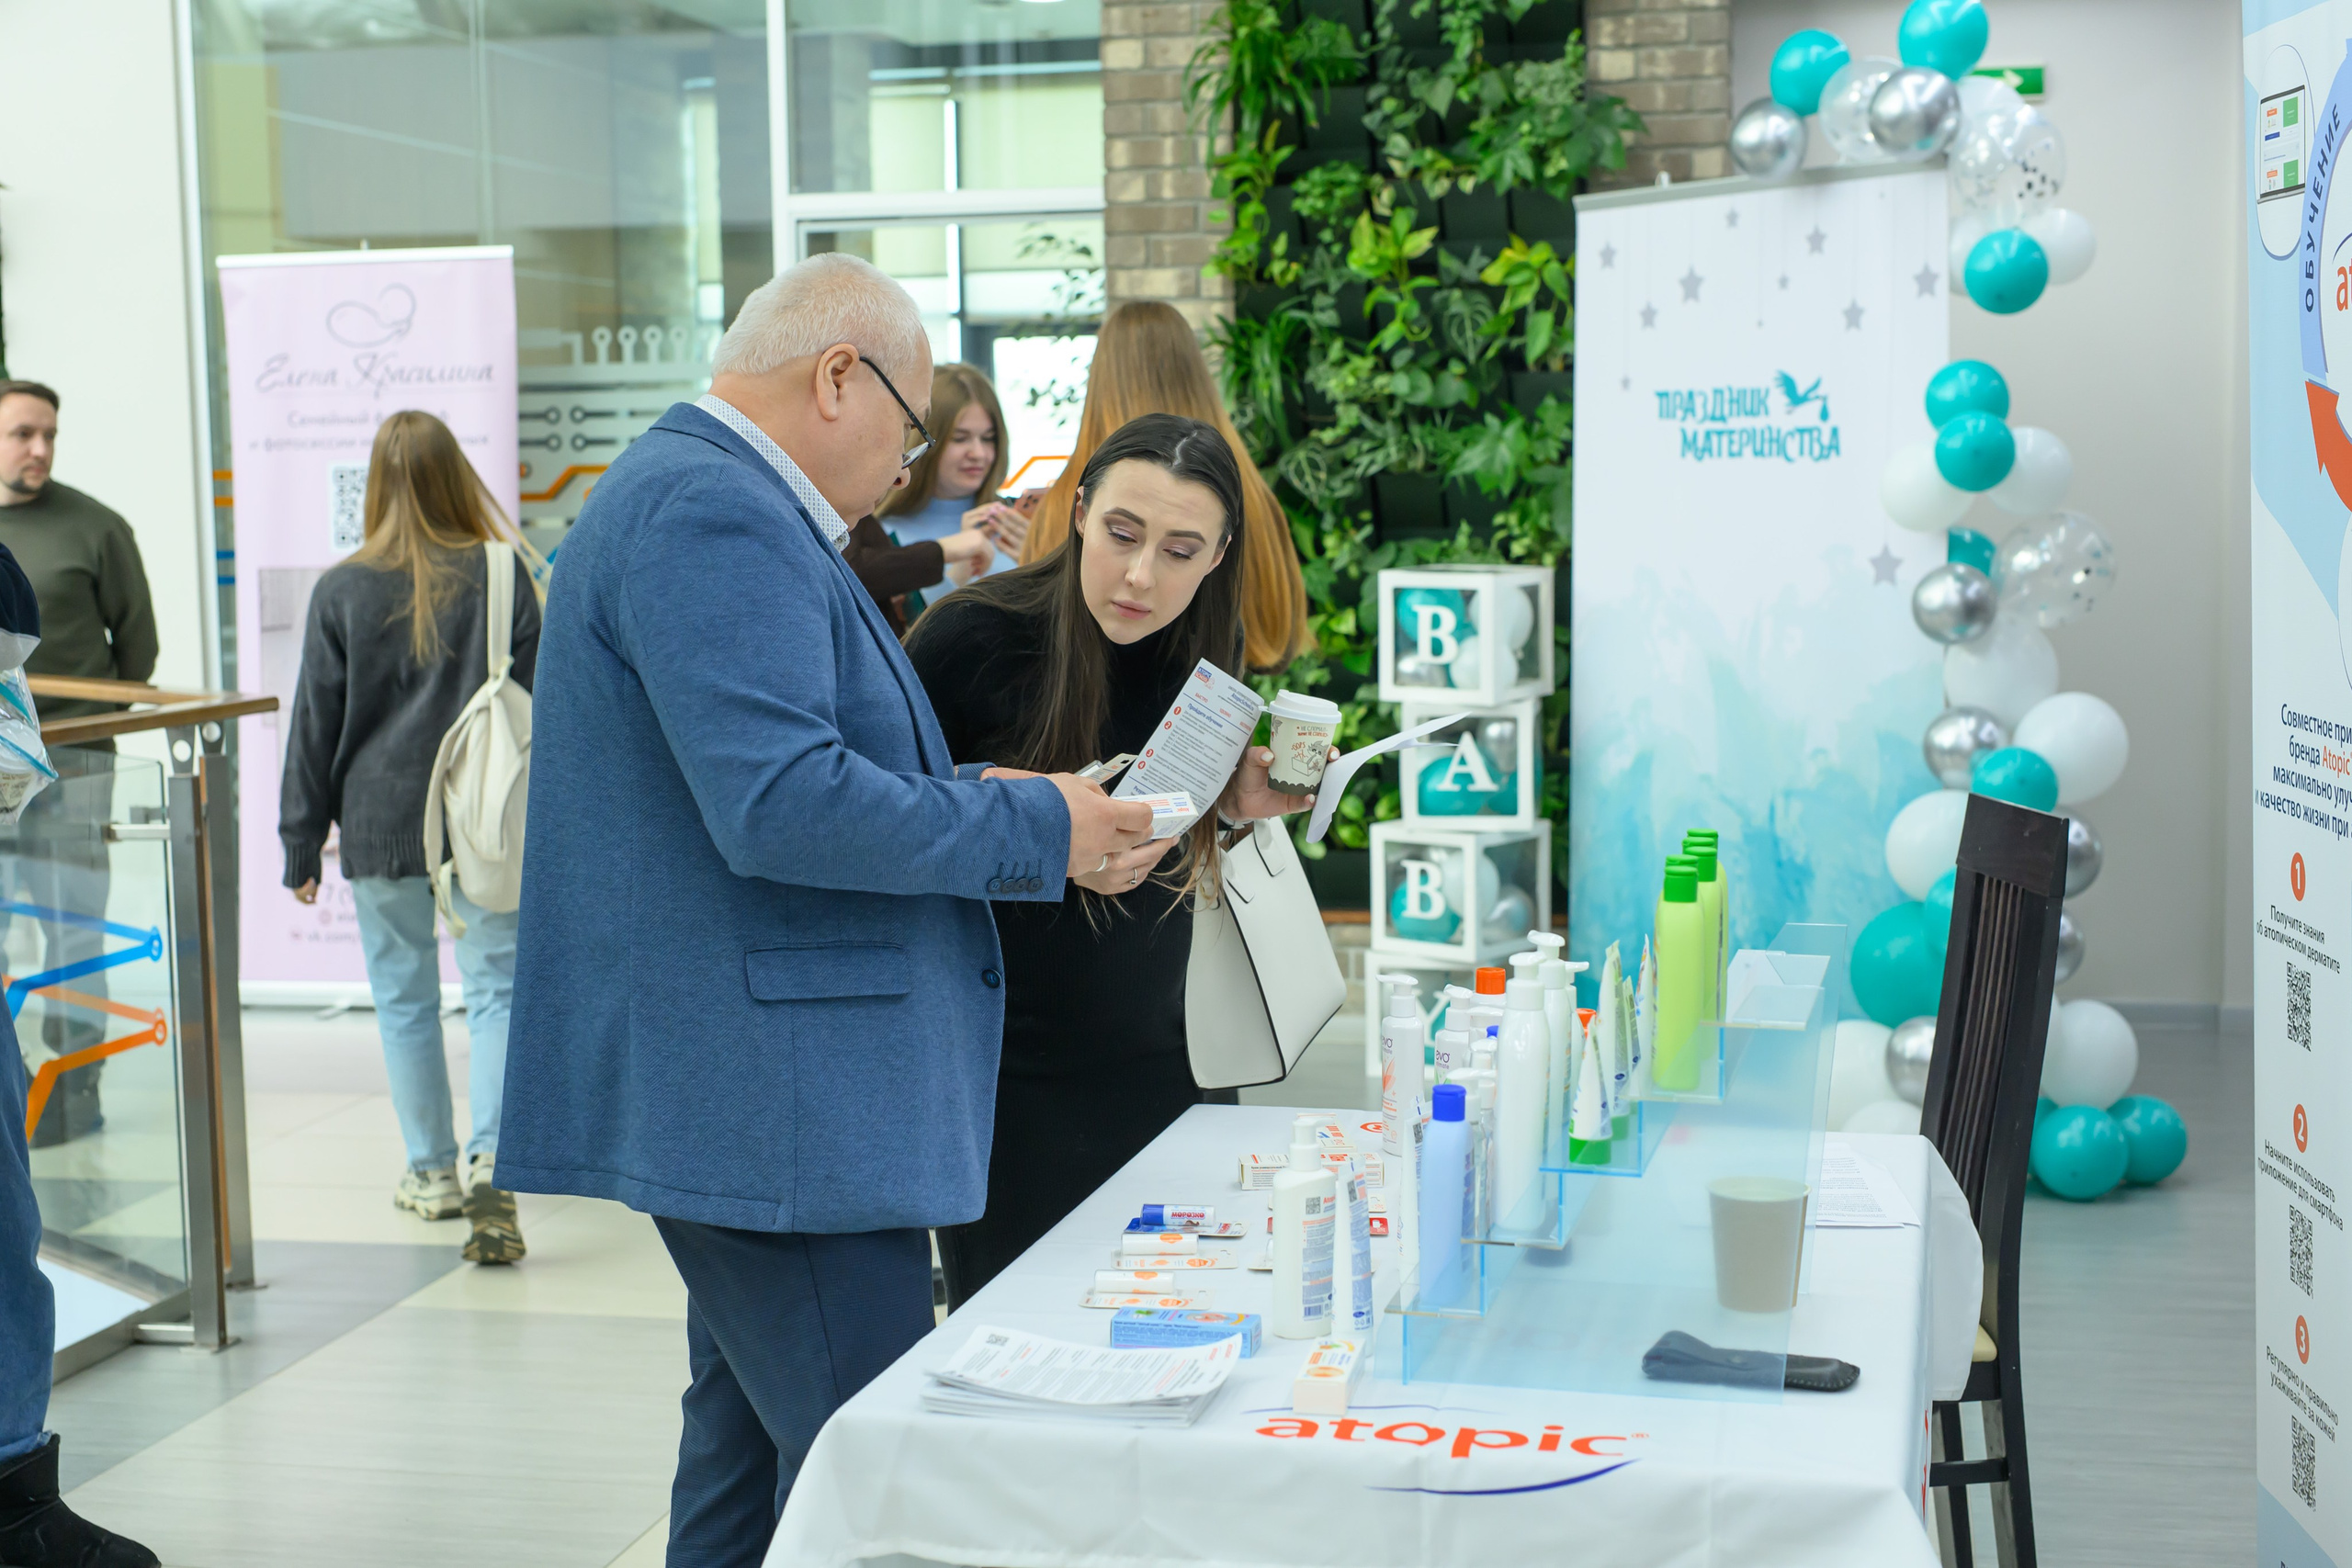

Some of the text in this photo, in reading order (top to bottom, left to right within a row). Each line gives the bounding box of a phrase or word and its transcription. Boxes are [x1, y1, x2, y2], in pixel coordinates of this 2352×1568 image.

[2304, 103, 2341, 313] ОБУЧЕНИЕ
[1655, 386, 1770, 423] ПРАЗДНИК
[1679, 424, 1841, 463] МАТЕРИНСТВА
[1411, 604, 1459, 664] B
[2281, 704, 2333, 739] Совместное
[1436, 730, 1499, 792] A
[2289, 735, 2321, 769] бренда
[2273, 765, 2332, 800] максимально
[2260, 791, 2301, 819] качество
[2302, 805, 2330, 830] жизни
[2332, 817, 2350, 840] при
[1399, 860, 1447, 919] B
[2256, 919, 2341, 975] об атопическом дерматите
[2270, 904, 2325, 944] Получите знания
[2257, 1157, 2344, 1232] приложение для смартфона
[2265, 1139, 2335, 1203] Начните использовать
[1170, 1211, 1205, 1219] МОРОЗКО
[2267, 1345, 2300, 1386] Регулярно
[2305, 1383, 2339, 1427] правильно
[2270, 1371, 2335, 1444] ухаживайте за кожей
